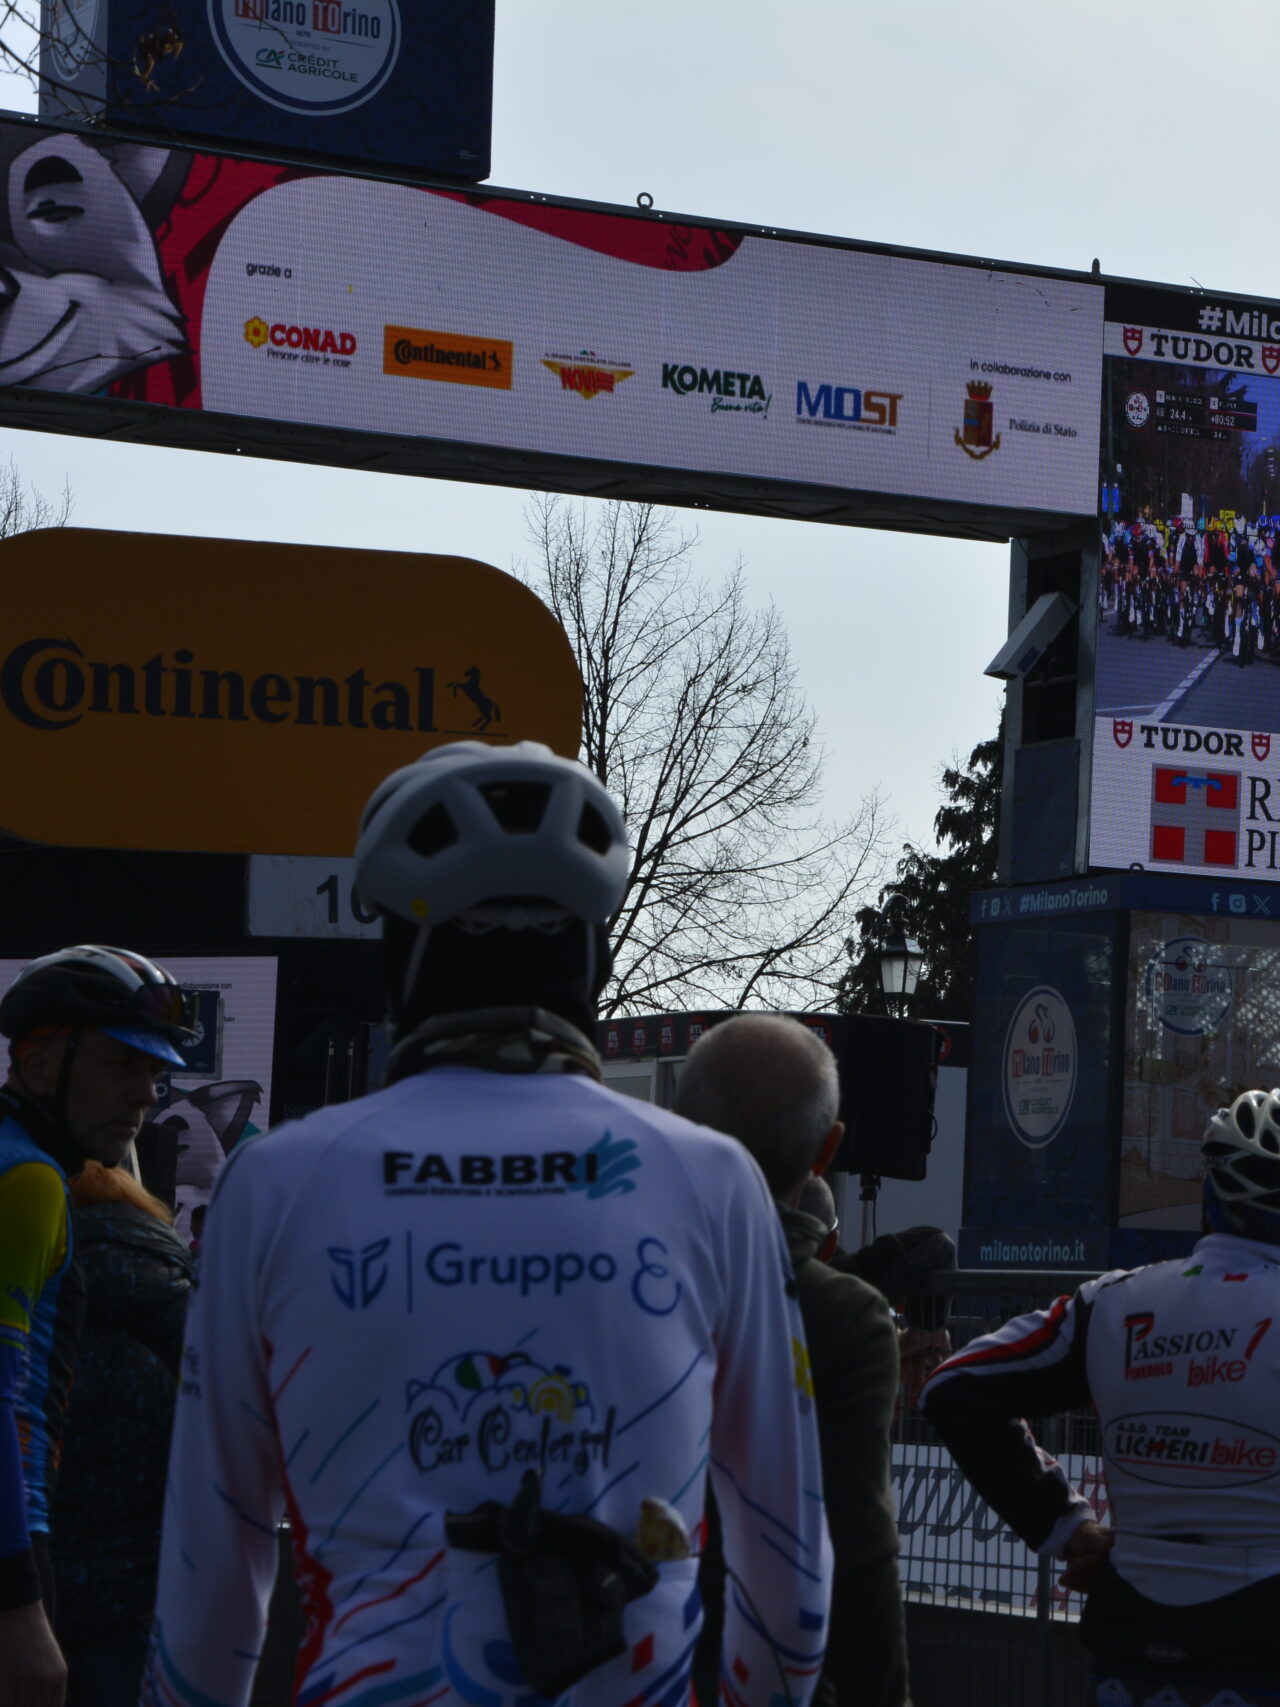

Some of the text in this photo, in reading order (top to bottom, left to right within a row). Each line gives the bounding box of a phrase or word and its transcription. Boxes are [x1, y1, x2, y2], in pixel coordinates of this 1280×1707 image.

[287, 52, 340, 69] CRÉDIT
[287, 62, 359, 83] AGRICOLE
[245, 262, 292, 279] grazie a
[269, 322, 358, 355] CONAD
[393, 338, 487, 370] Continental
[1150, 331, 1255, 370] TUDOR
[660, 362, 767, 401] KOMETA
[980, 361, 1051, 382] collaborazione
[1053, 371, 1073, 384] con
[796, 380, 905, 428] MOST
[1008, 417, 1078, 438] Polizia di Stato
[0, 637, 439, 733] Continental
[1140, 724, 1245, 757] TUDOR
[1018, 884, 1109, 914] #MilanoTorino
[382, 1150, 599, 1186] FABBRI
[979, 1238, 1086, 1262] milanotorino.it
[424, 1240, 618, 1298] Gruppo
[1124, 1311, 1239, 1370] PASSION
[1186, 1354, 1248, 1388] bike
[1154, 1424, 1192, 1439] TEAM
[1209, 1436, 1278, 1468] bike
